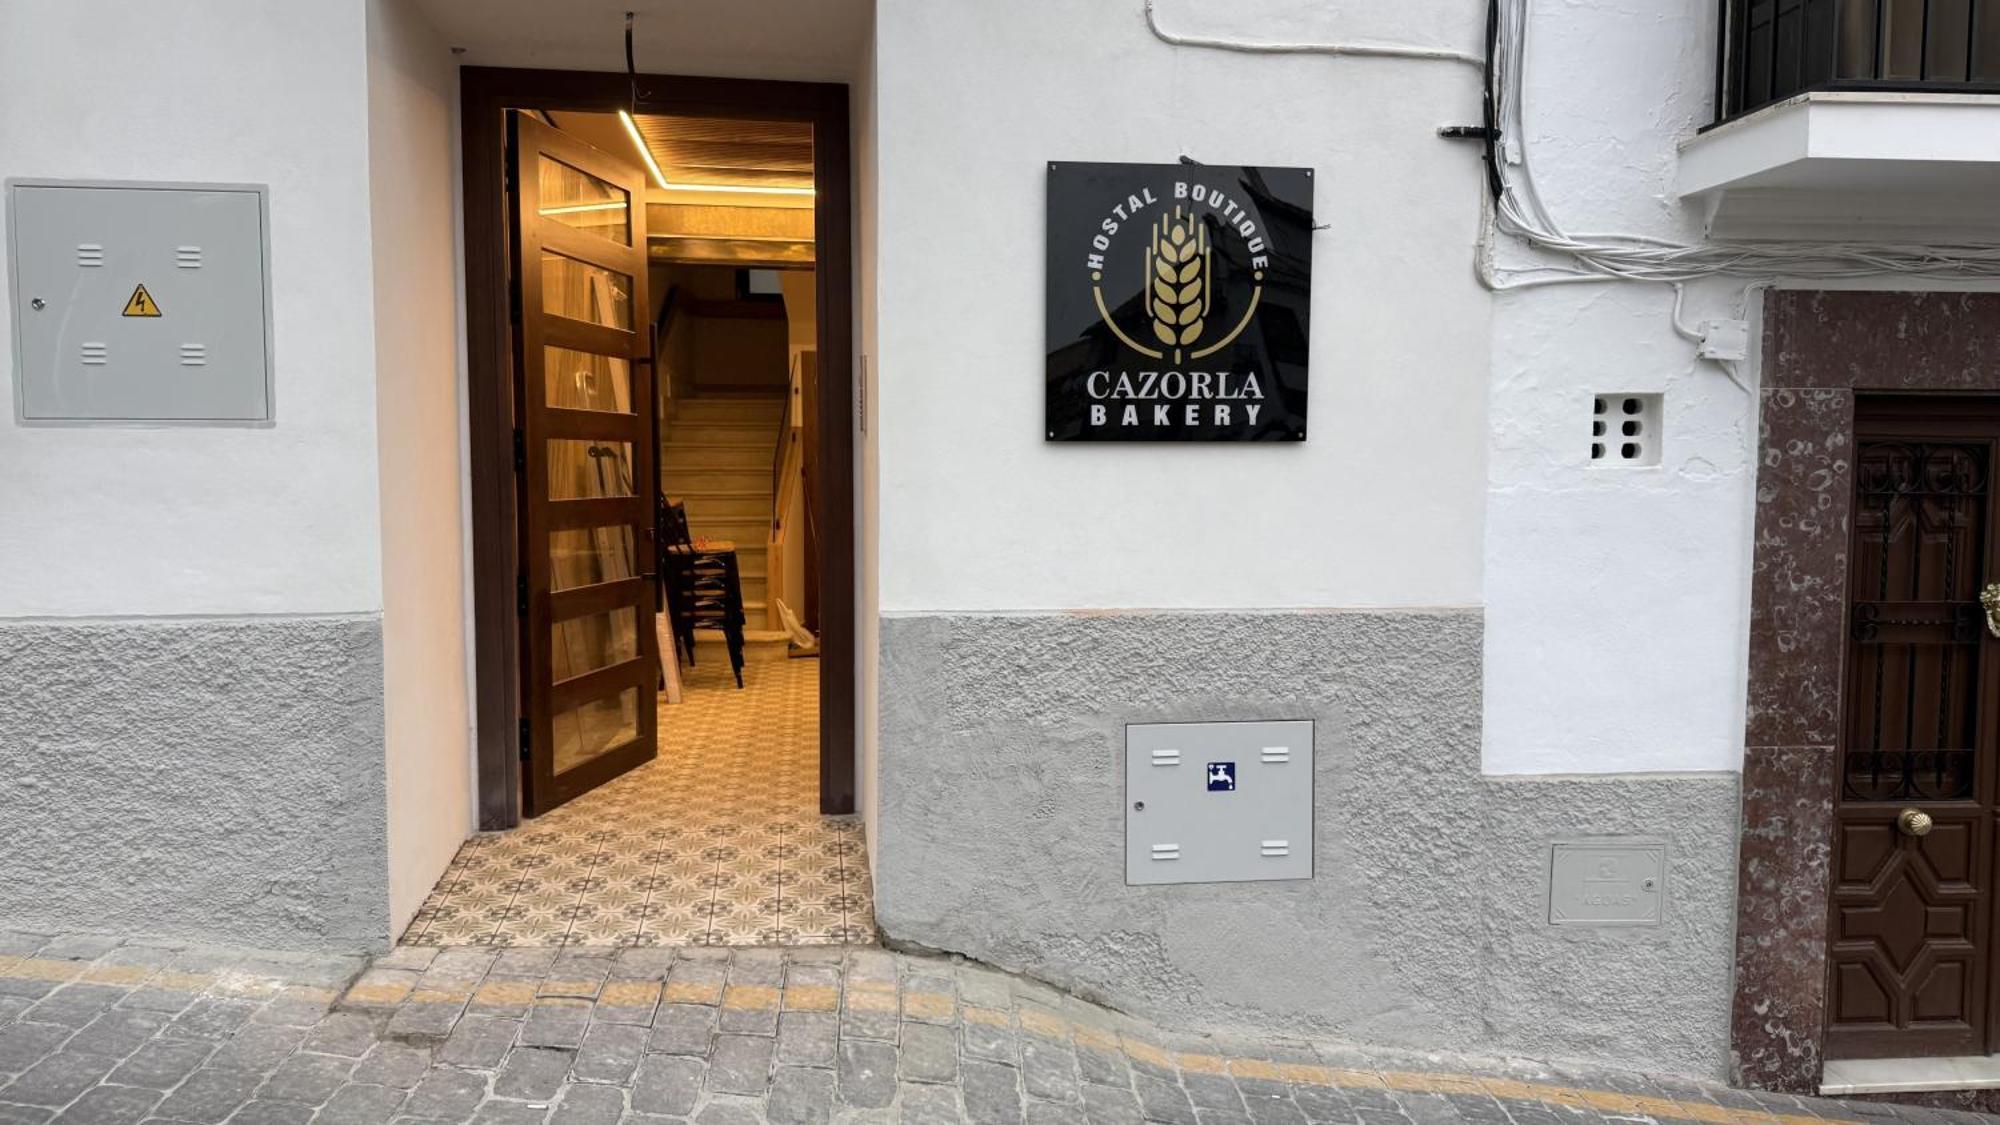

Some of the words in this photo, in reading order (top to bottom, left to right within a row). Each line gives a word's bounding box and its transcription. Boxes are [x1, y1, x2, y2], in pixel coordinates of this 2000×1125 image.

[1087, 187, 1157, 270] HOSTAL
[1174, 181, 1268, 269] BOUTIQUE
[1087, 371, 1264, 399] CAZORLA
[1090, 404, 1261, 426] BAKERY
